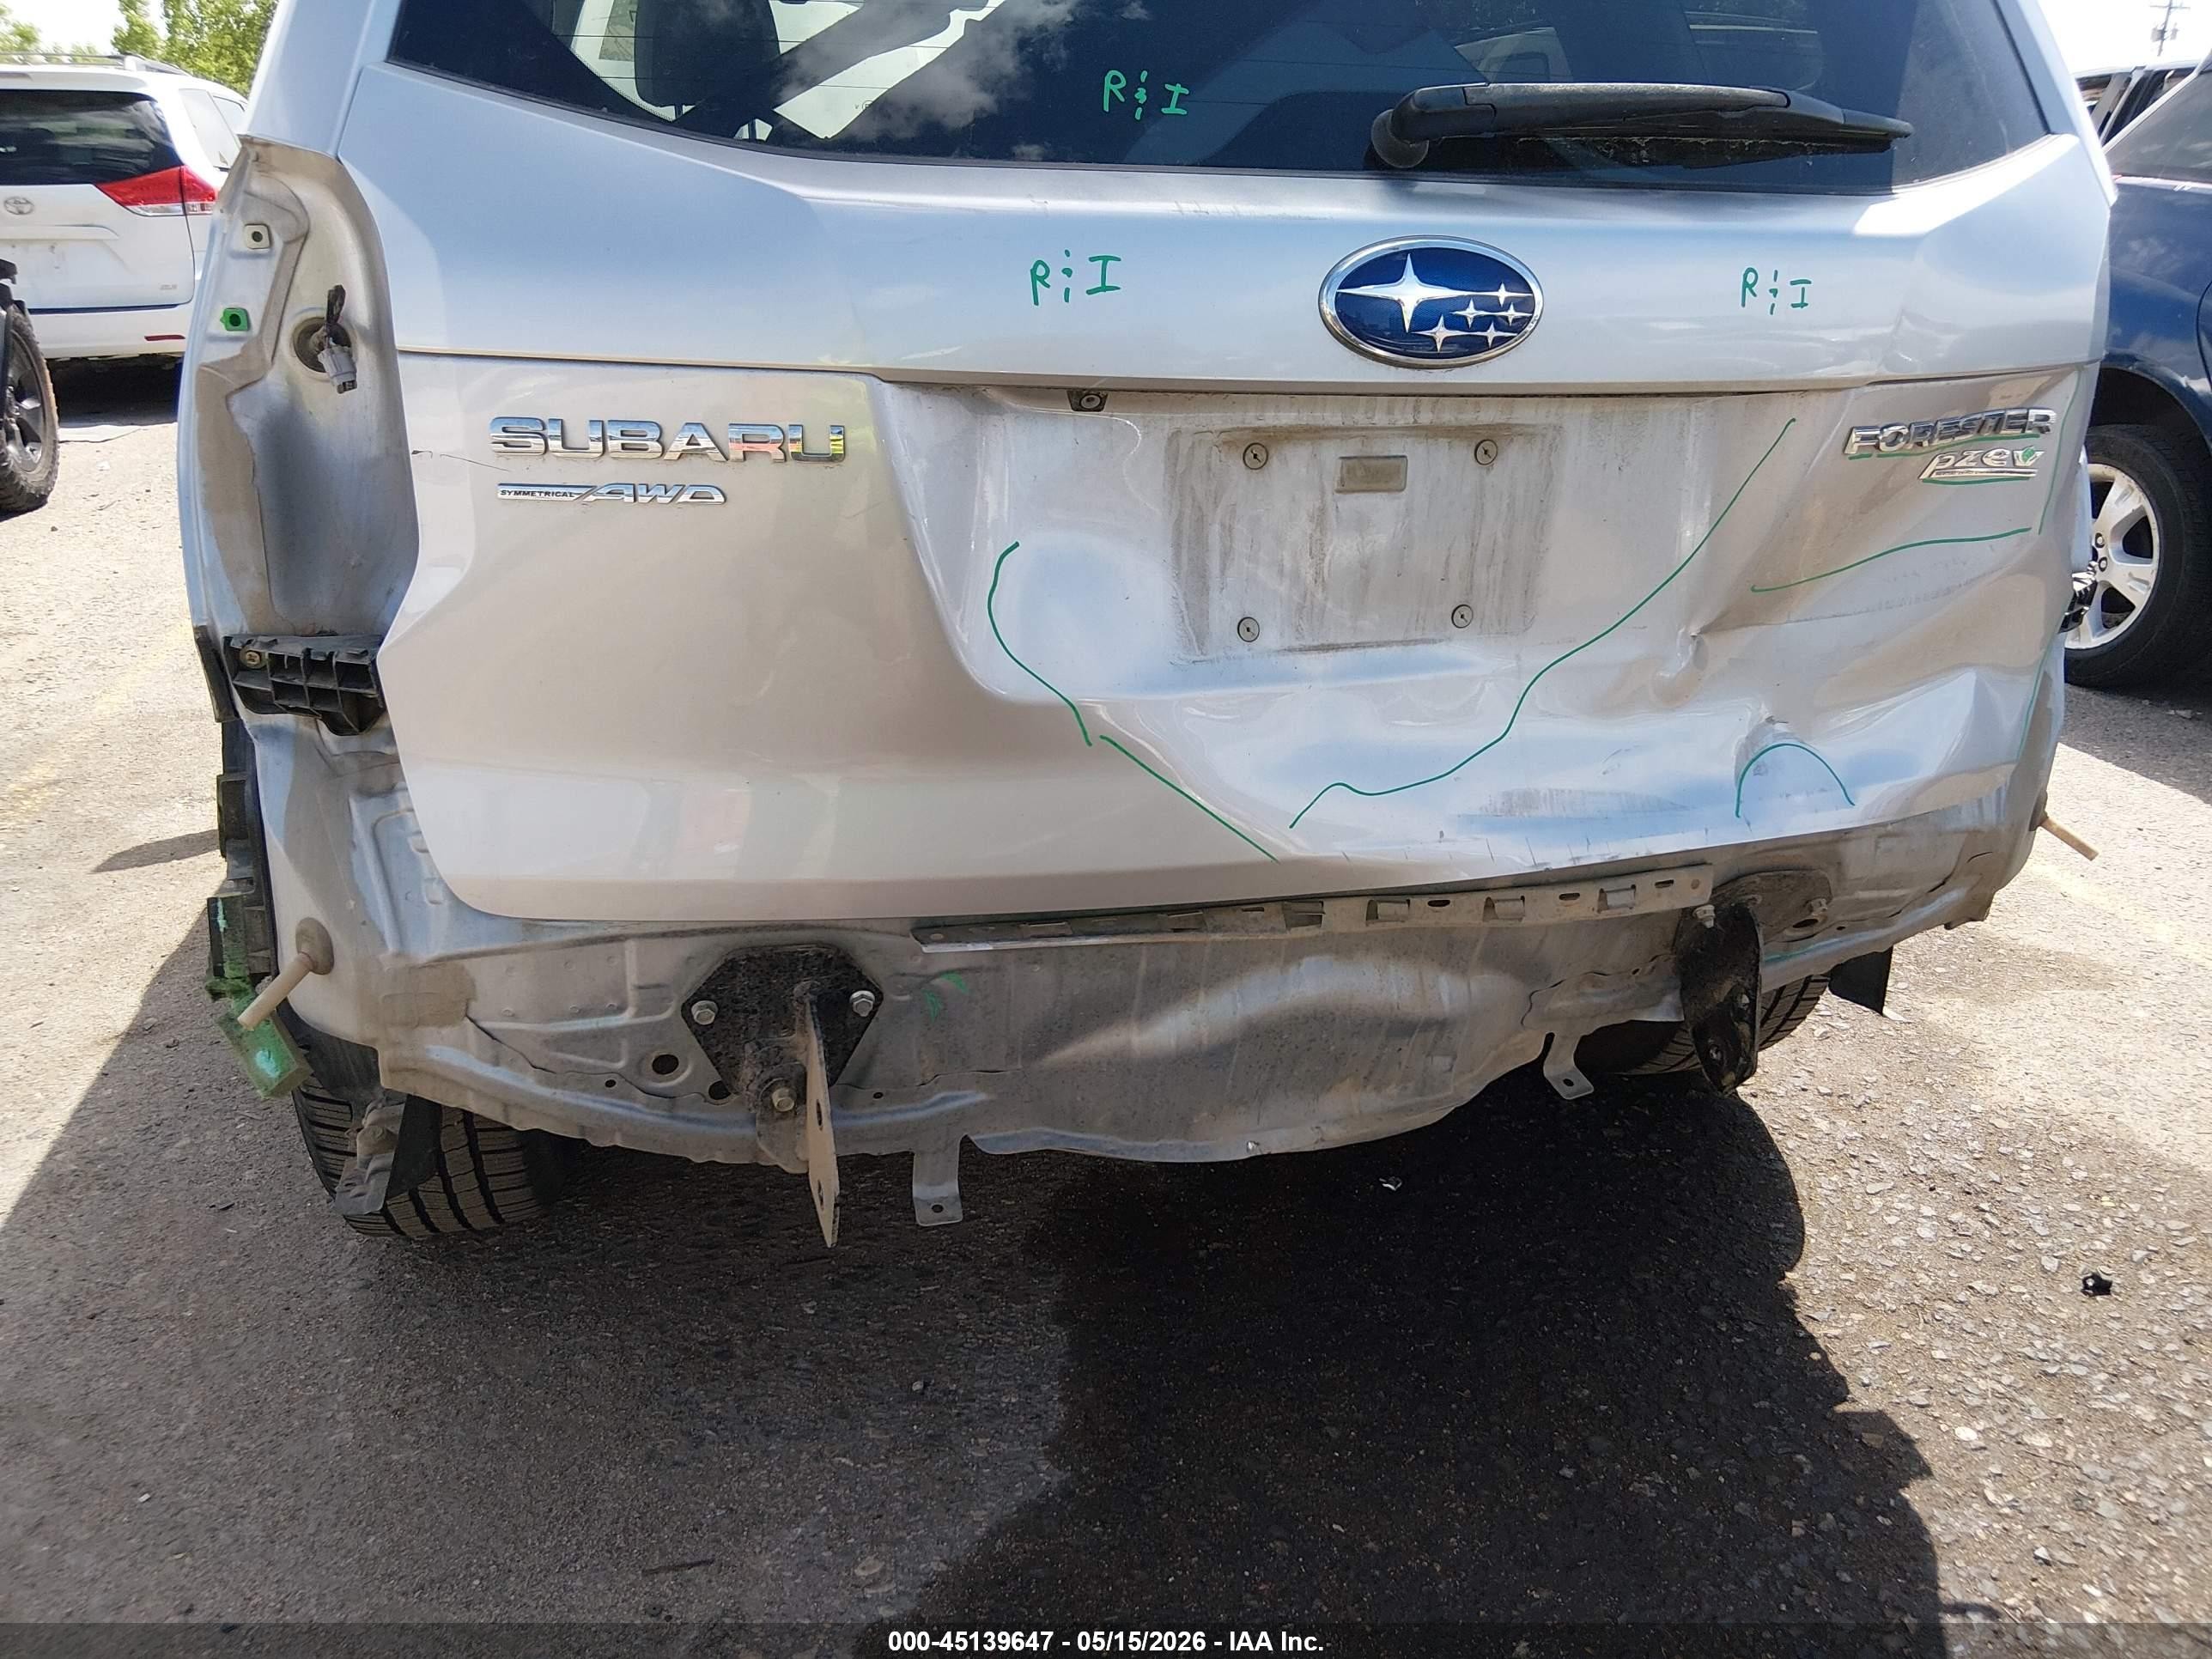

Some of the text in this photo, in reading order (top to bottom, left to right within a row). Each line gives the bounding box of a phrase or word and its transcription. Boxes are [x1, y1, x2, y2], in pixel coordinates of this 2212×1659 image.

[489, 416, 846, 463] SUBARU
[1844, 407, 2057, 454] FORESTER
[501, 483, 727, 505] SYMMETRICAL AWD
